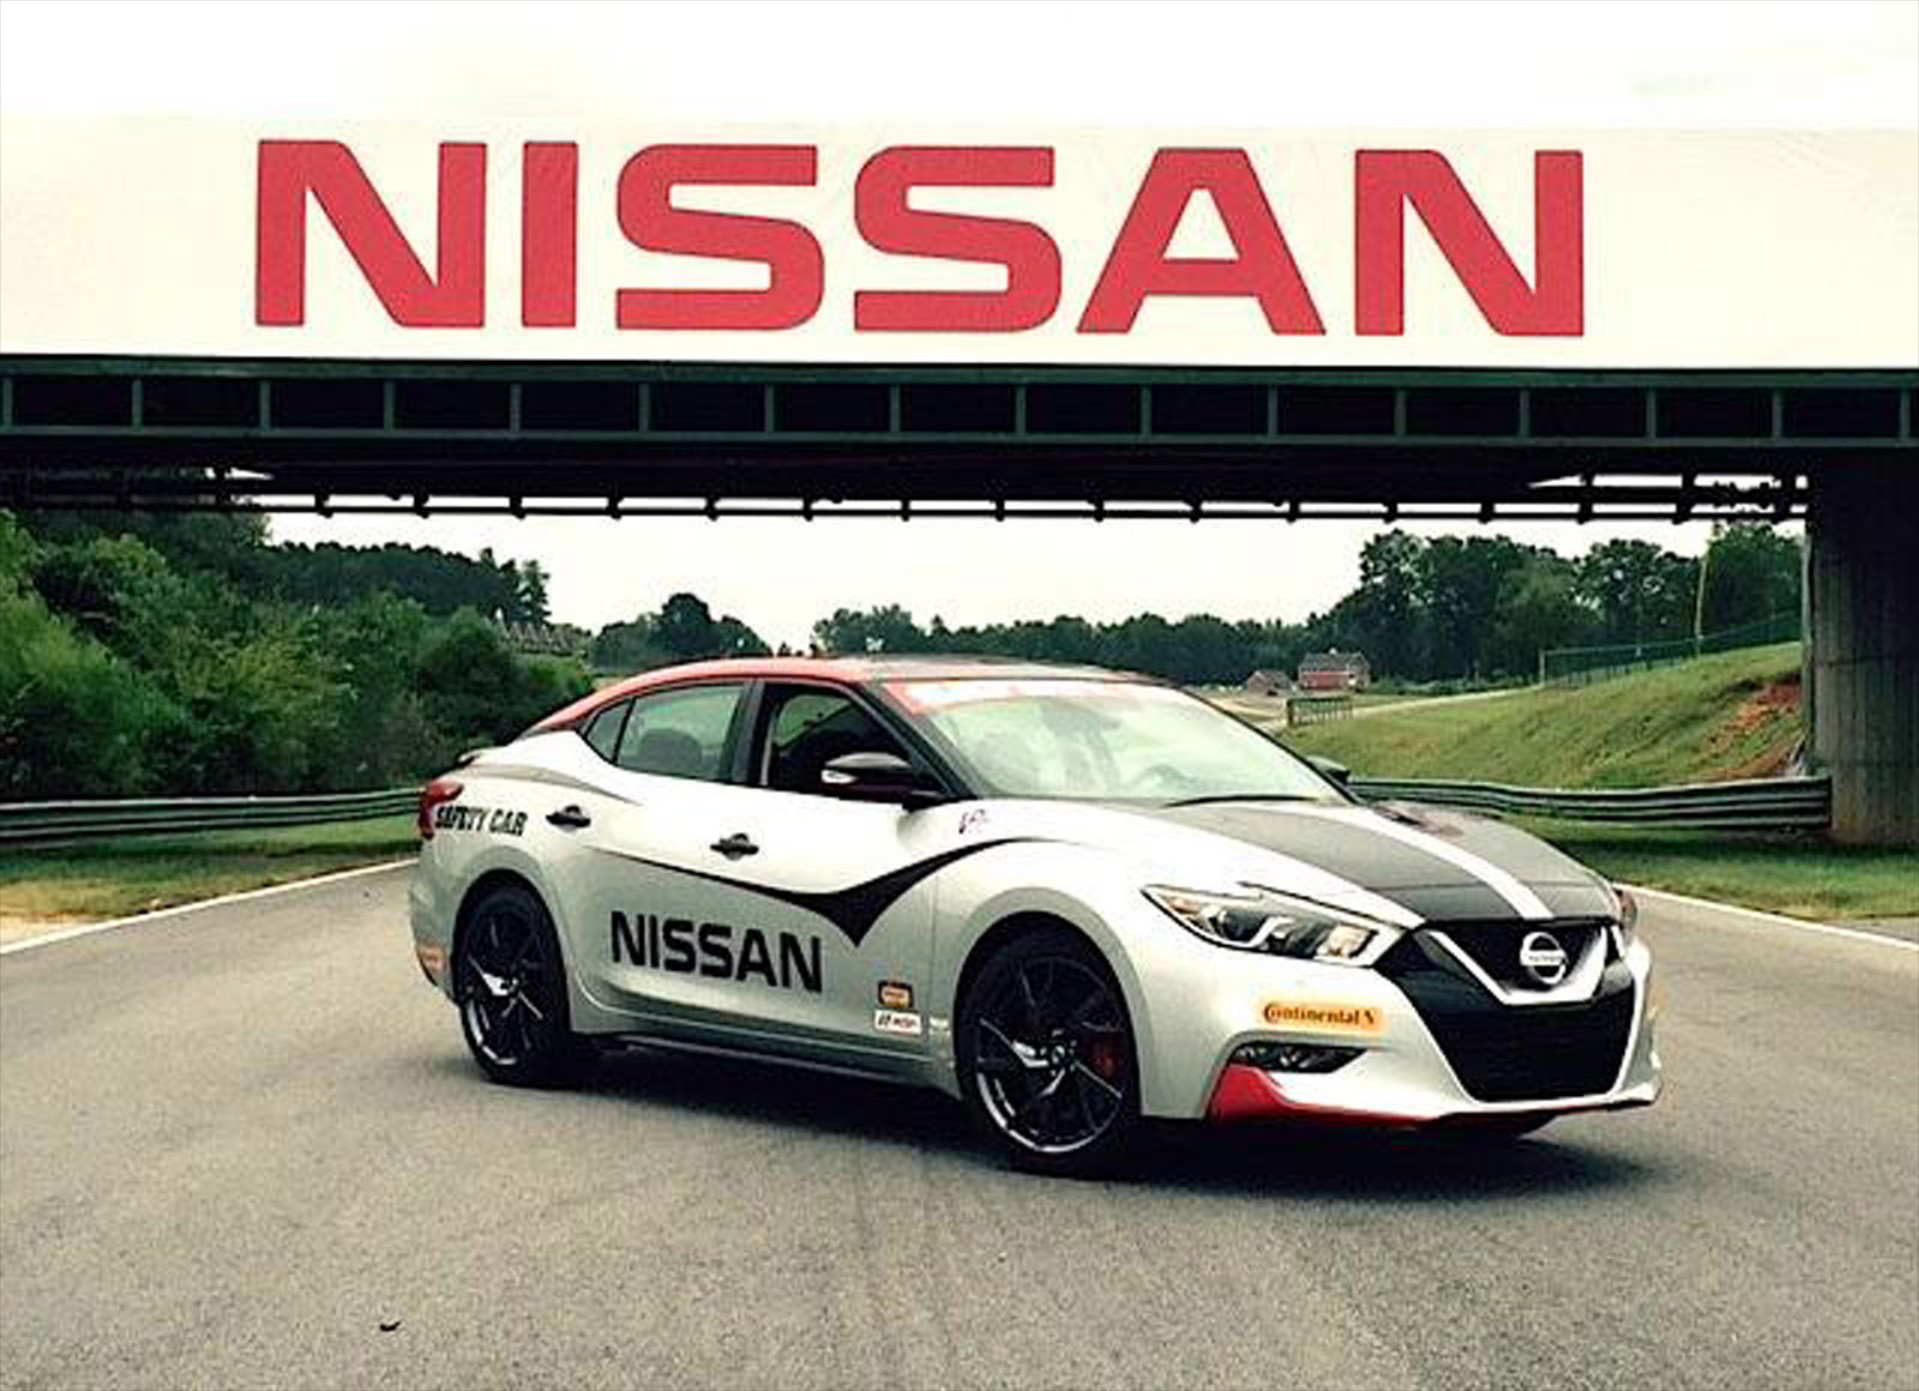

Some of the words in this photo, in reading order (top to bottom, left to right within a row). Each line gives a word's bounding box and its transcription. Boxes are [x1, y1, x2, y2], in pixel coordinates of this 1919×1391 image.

[255, 139, 1584, 336] NISSAN
[436, 806, 490, 831] SAFETY
[489, 808, 528, 836] CAR
[611, 910, 823, 993] NISSAN
[1263, 1002, 1360, 1026] Continental
